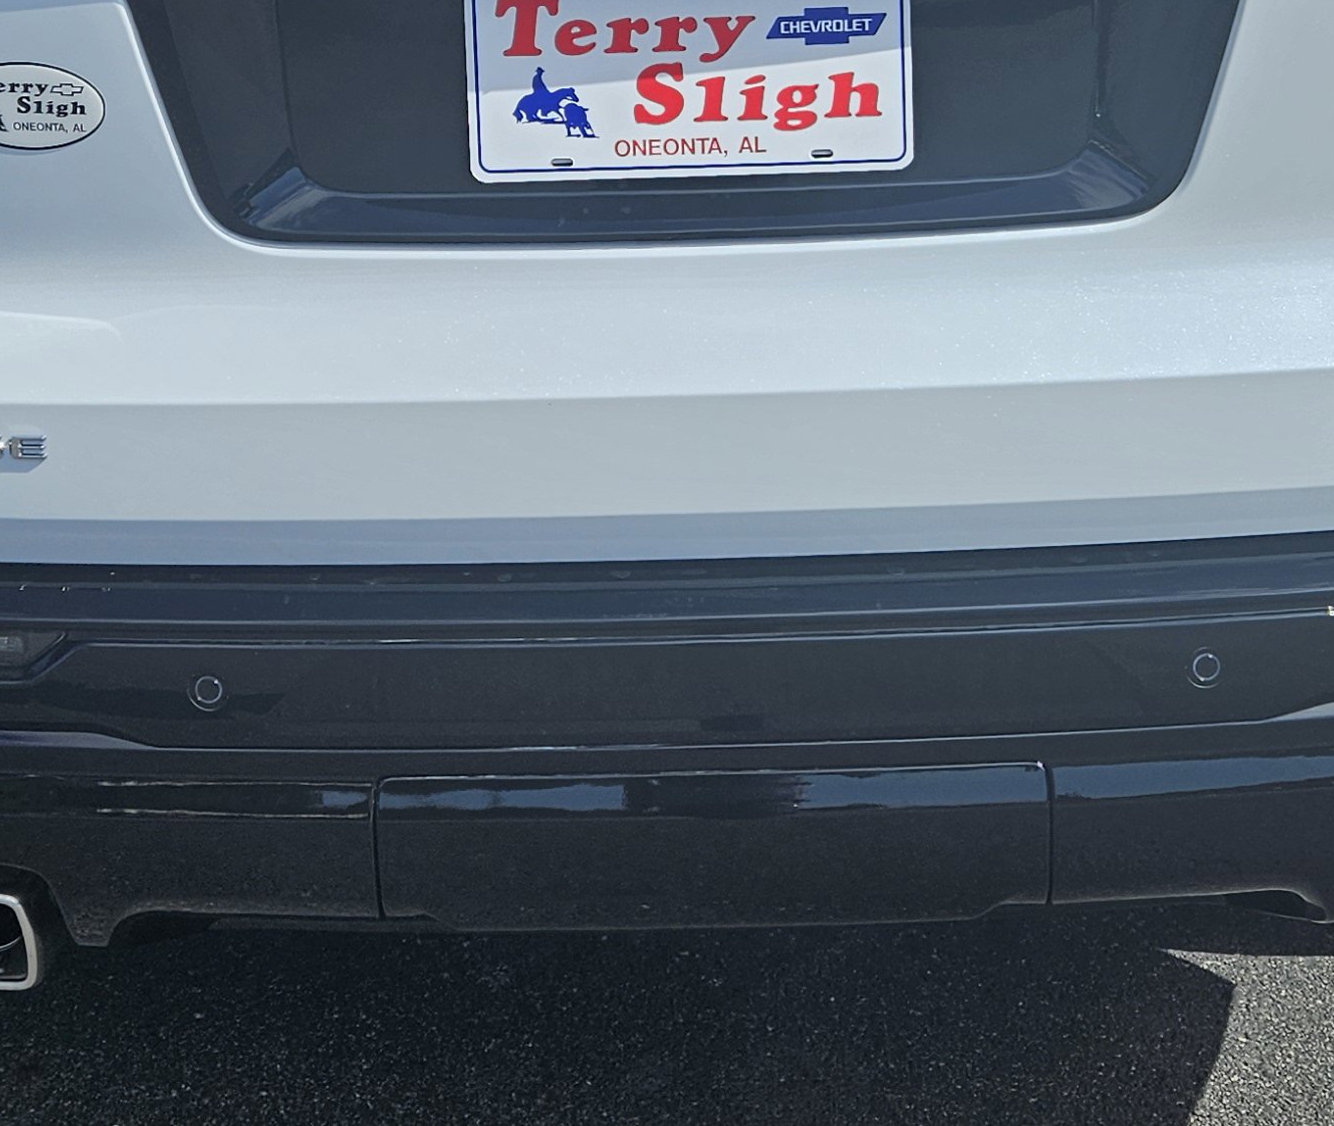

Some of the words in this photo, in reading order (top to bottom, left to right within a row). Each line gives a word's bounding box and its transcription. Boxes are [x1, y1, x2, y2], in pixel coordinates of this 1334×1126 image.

[780, 18, 873, 34] CHEVROLET
[17, 96, 87, 117] Sligh
[634, 62, 882, 131] Sligh
[13, 121, 68, 133] ONEONTA,
[73, 123, 87, 132] AL
[614, 138, 728, 157] ONEONTA,
[739, 136, 767, 153] AL
